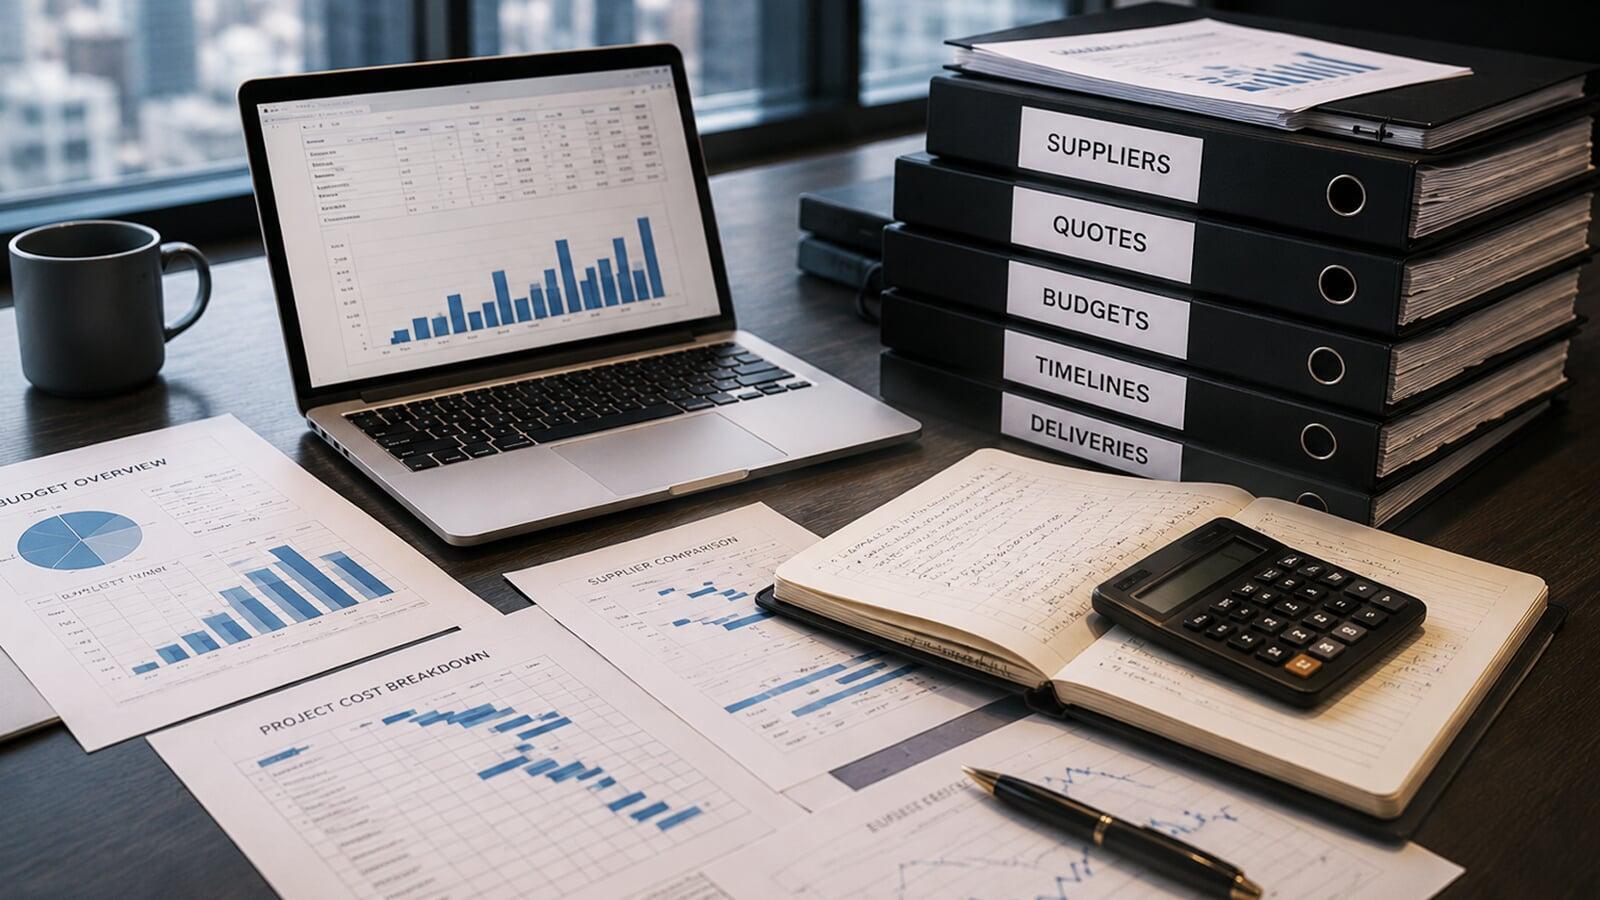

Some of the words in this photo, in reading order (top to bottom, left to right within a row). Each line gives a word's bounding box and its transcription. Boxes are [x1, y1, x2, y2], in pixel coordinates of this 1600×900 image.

[1047, 133, 1171, 174] SUPPLIERS
[1053, 215, 1147, 253] QUOTES
[1042, 287, 1149, 331] BUDGETS
[1035, 355, 1150, 403] TIMELINES
[1031, 413, 1148, 465] DELIVERIES
[0, 482, 69, 507] BUDGET
[74, 458, 167, 487] OVERVIEW
[588, 561, 653, 586] SUPPLIER
[654, 536, 739, 566] COMPARISON
[259, 702, 335, 736] PROJECT
[339, 686, 384, 707] COST
[385, 650, 491, 692] BREAKDOWN
